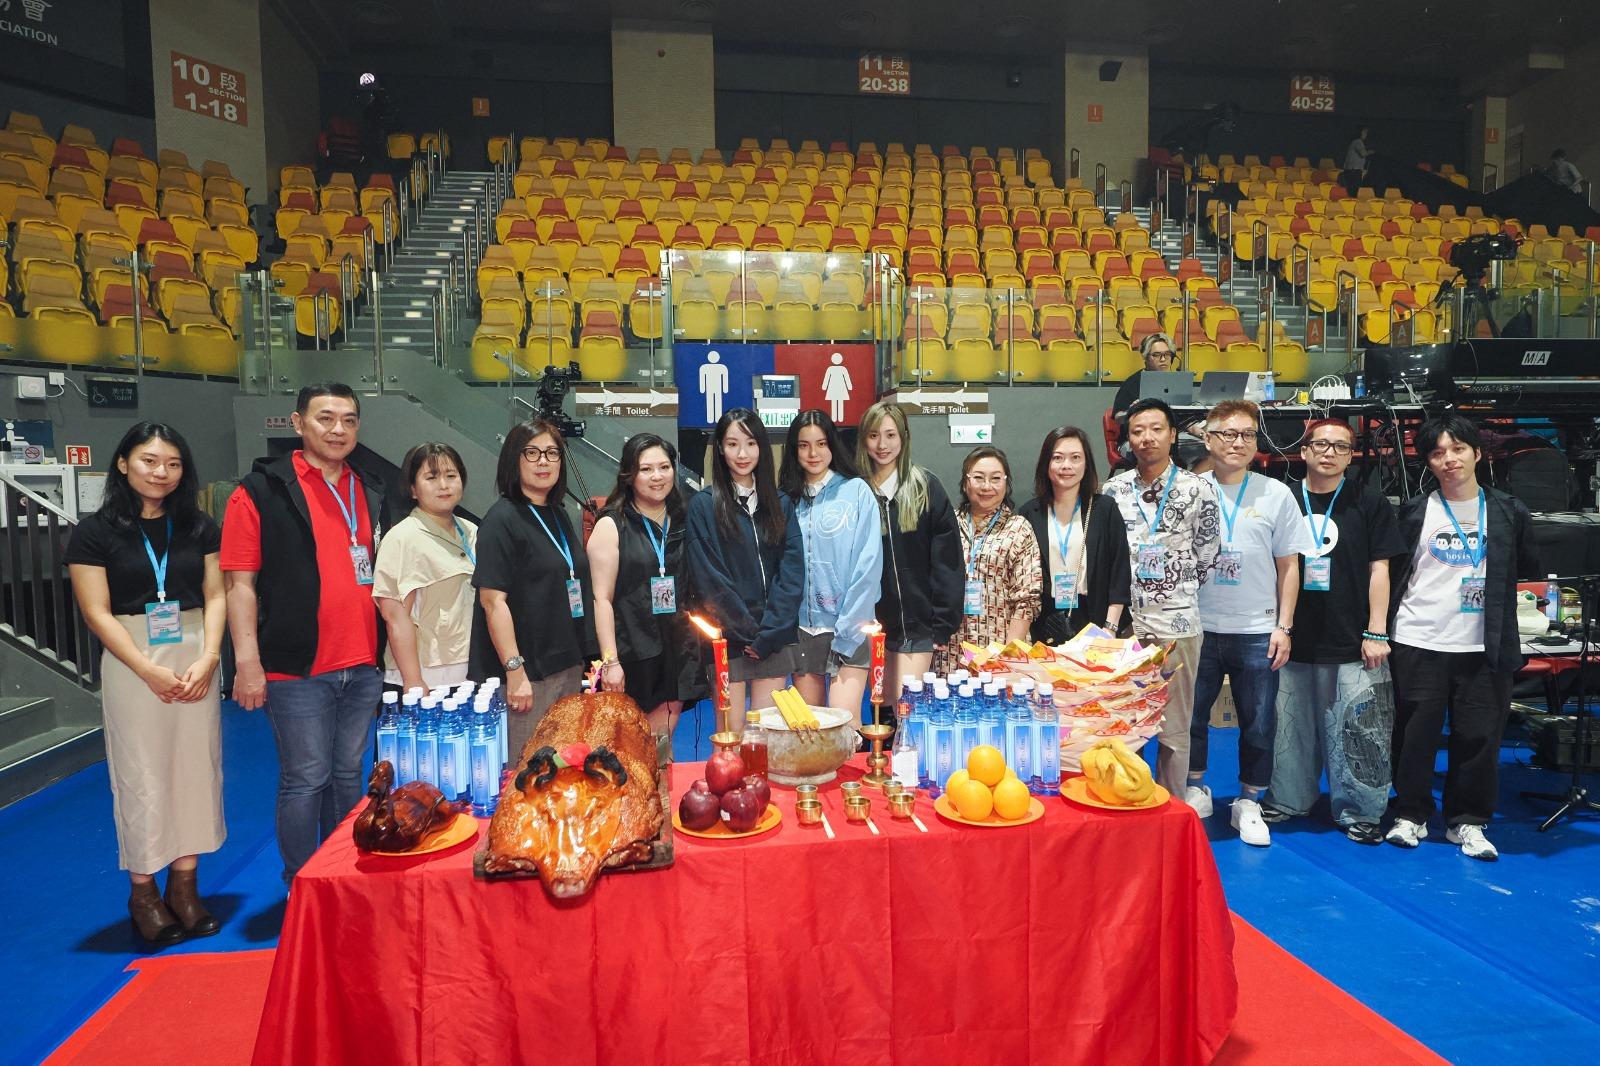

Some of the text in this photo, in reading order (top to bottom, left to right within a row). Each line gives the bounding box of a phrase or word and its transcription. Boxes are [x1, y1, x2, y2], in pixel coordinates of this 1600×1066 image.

[861, 55, 882, 70] 11
[174, 58, 238, 93] 10 段
[1293, 75, 1313, 90] 12
[861, 77, 908, 92] 20-38
[208, 87, 245, 103] SECTION
[185, 92, 237, 122] 1-18
[1291, 96, 1333, 111] 40-52
[1311, 323, 1320, 335] A
[1398, 324, 1407, 337] A
[595, 406, 649, 416] 洗手間 Toilet
[922, 405, 969, 414] 洗手間 Toilet
